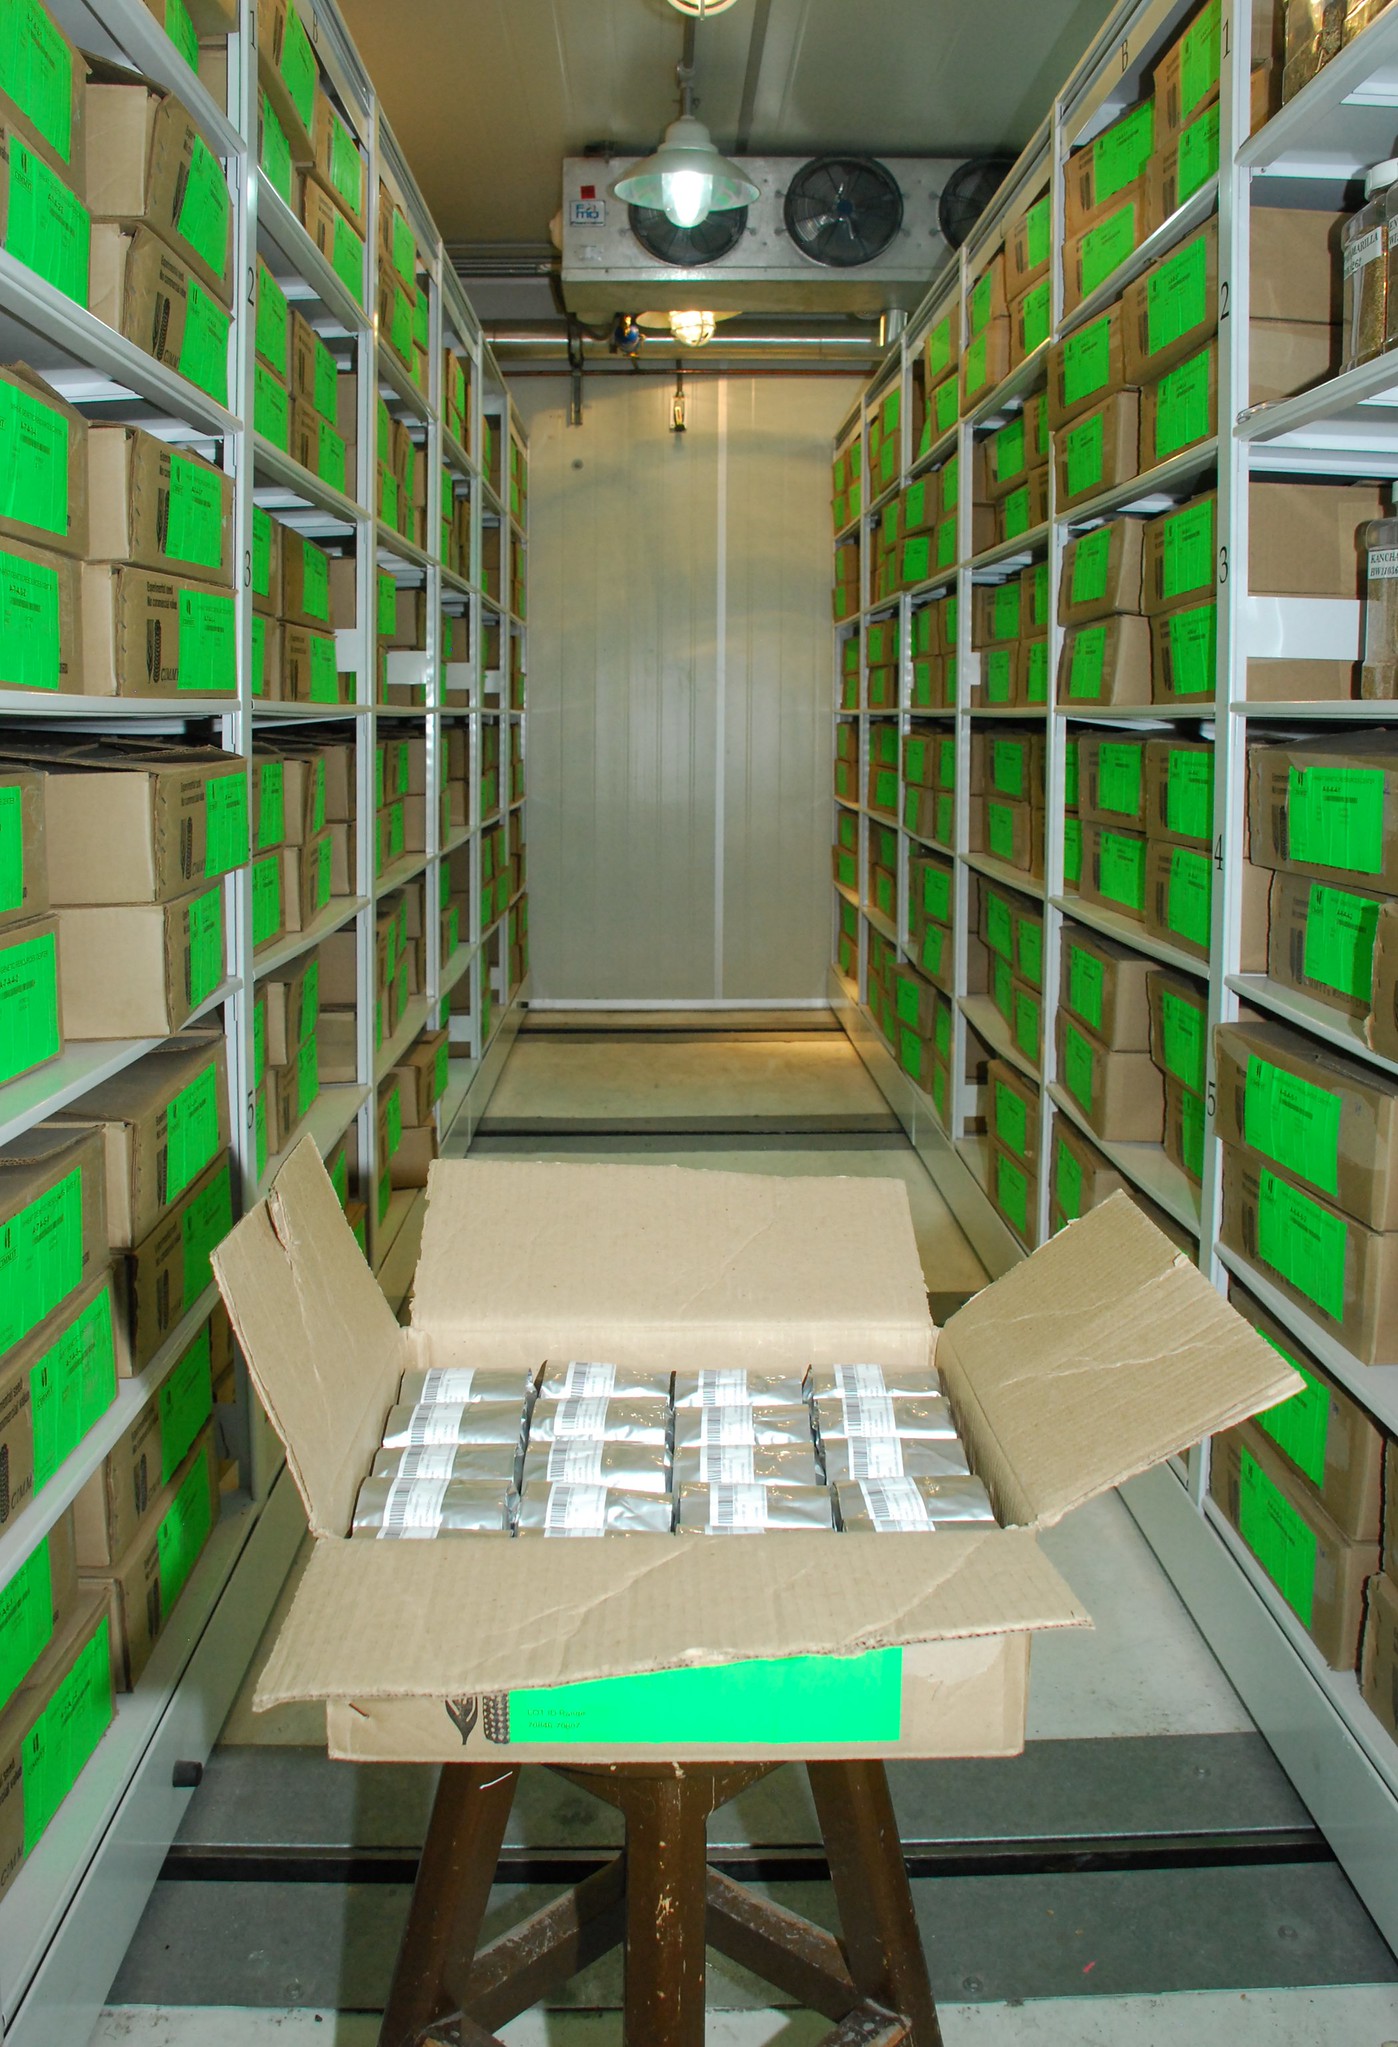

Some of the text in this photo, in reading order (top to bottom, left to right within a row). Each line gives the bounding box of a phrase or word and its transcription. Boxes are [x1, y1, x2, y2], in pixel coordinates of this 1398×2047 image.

[1121, 39, 1129, 73] B
[1222, 19, 1231, 59] 1
[247, 266, 254, 306] 2
[1220, 281, 1230, 321] 2
[244, 550, 252, 587] 3
[1219, 545, 1229, 584] 3
[1214, 834, 1223, 870] 4
[1207, 1081, 1216, 1117] 5
